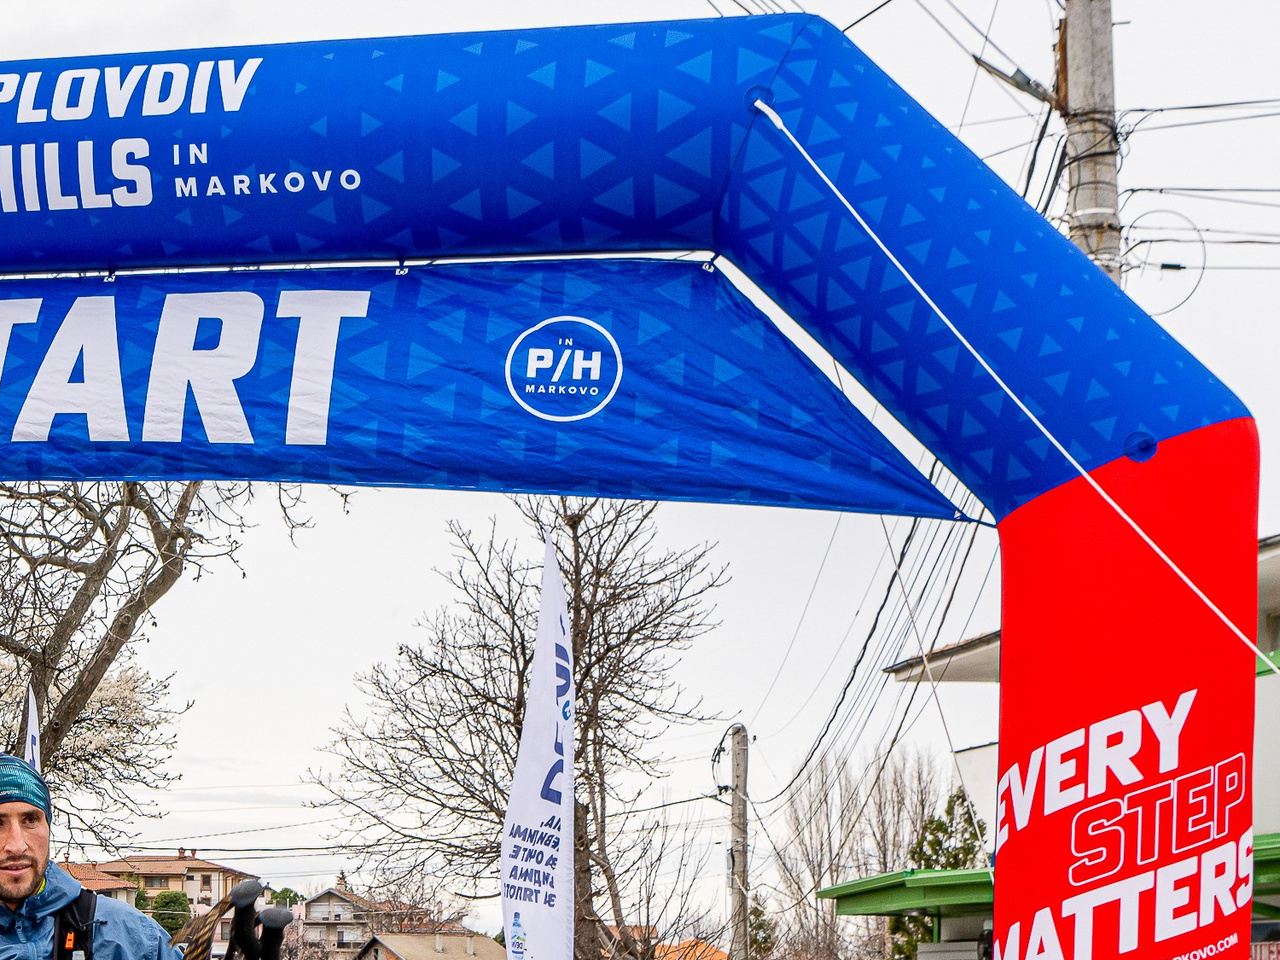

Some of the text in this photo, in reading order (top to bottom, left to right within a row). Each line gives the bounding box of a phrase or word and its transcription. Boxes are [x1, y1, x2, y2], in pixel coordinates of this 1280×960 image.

[173, 142, 209, 165] IN
[174, 168, 362, 198] MARKOVO
[558, 338, 573, 346] IN
[526, 347, 602, 382] P/H
[525, 384, 600, 396] MARKOVO
[995, 688, 1198, 857] EVERY
[1068, 752, 1246, 887] STEP
